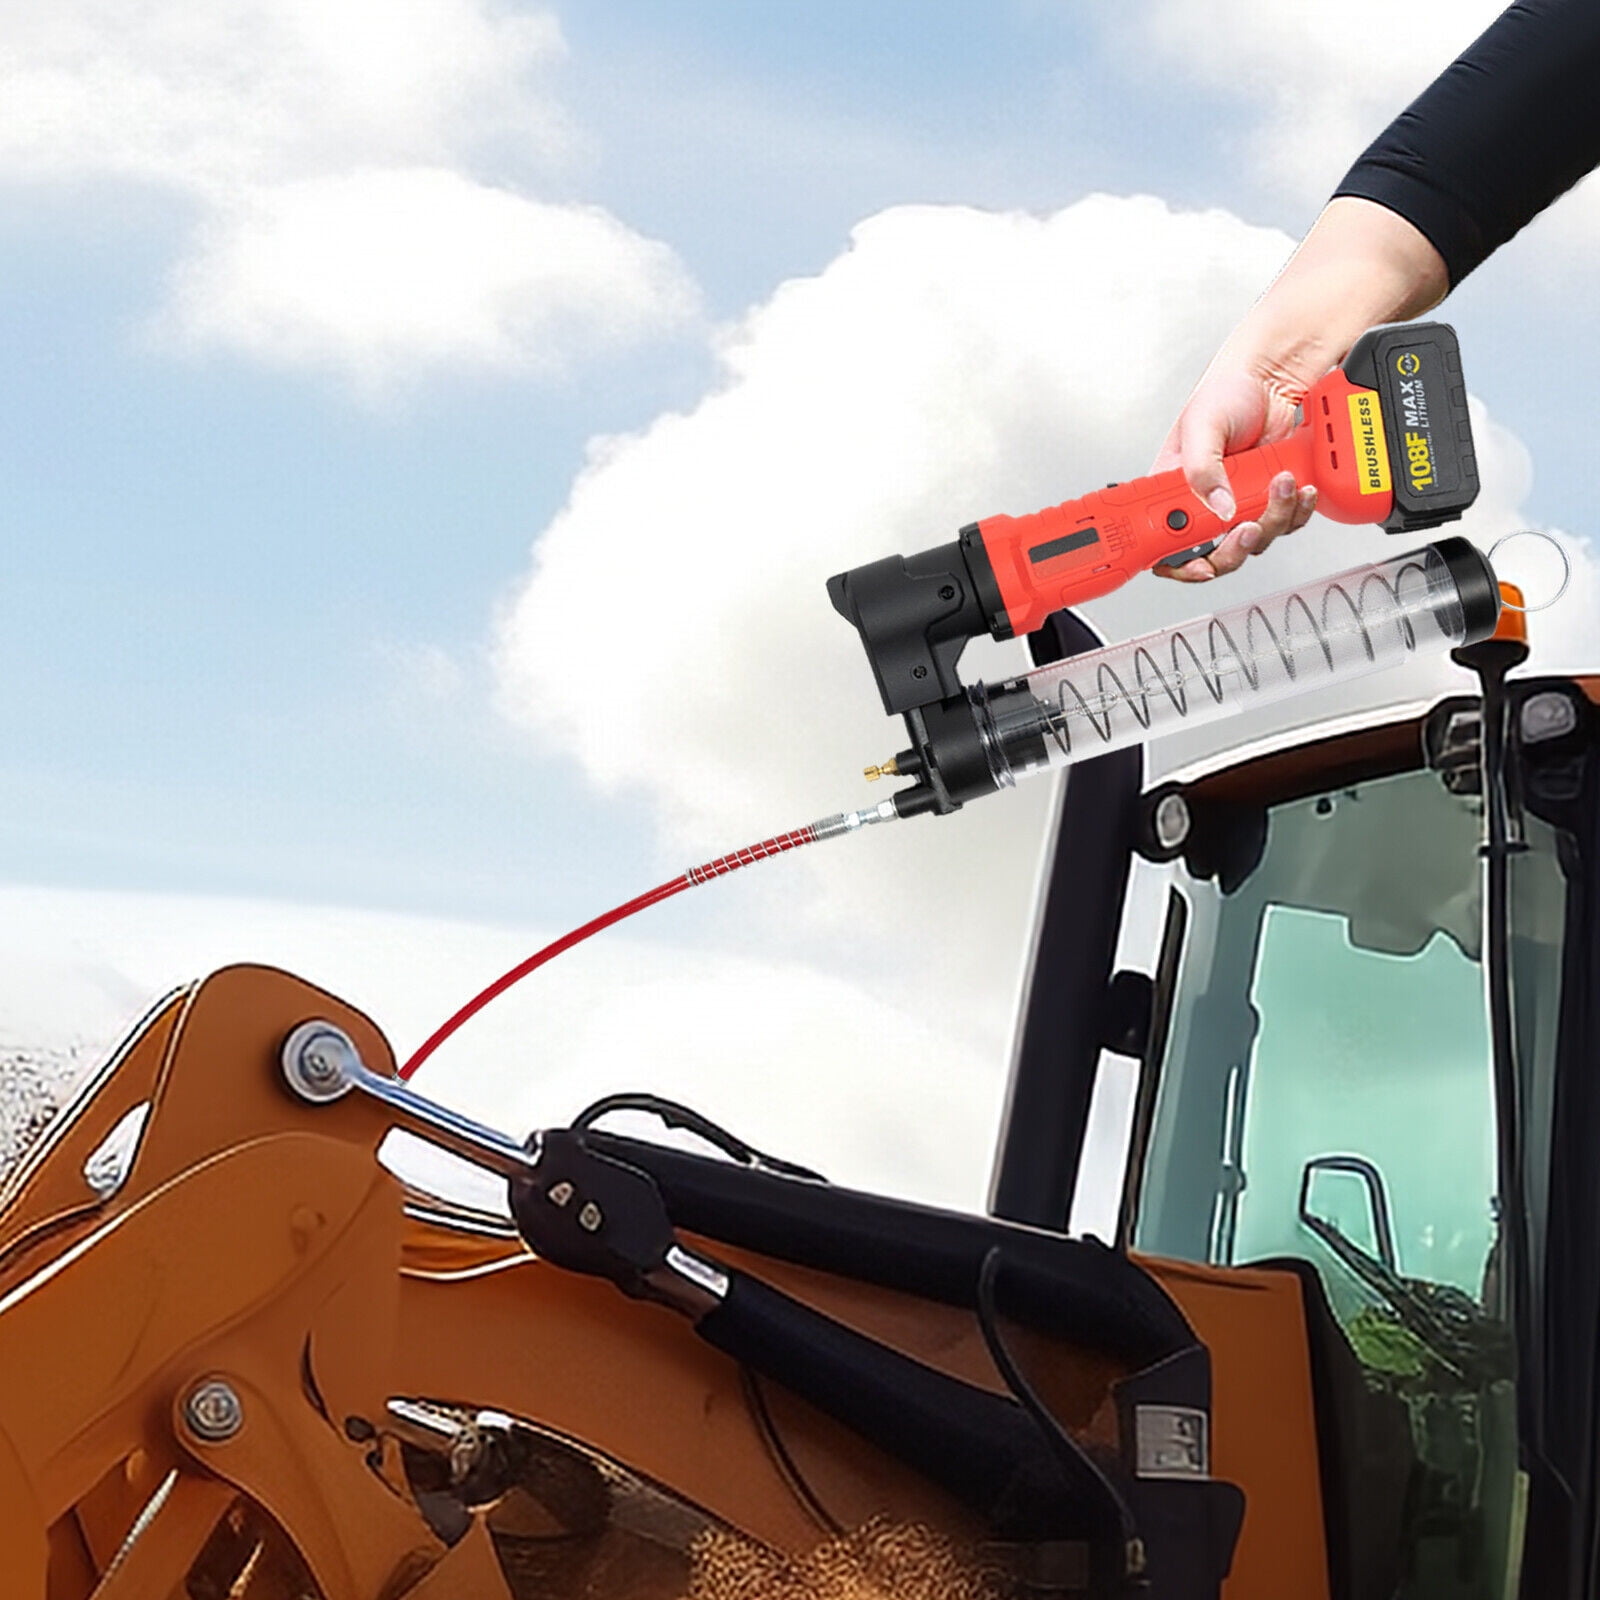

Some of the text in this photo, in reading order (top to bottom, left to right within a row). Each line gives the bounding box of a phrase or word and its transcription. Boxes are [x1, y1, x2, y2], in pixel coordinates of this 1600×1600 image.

[1359, 397, 1381, 488] BRUSHLESS
[1399, 381, 1433, 491] 108F MAX
[1414, 379, 1429, 428] LITHIUM
